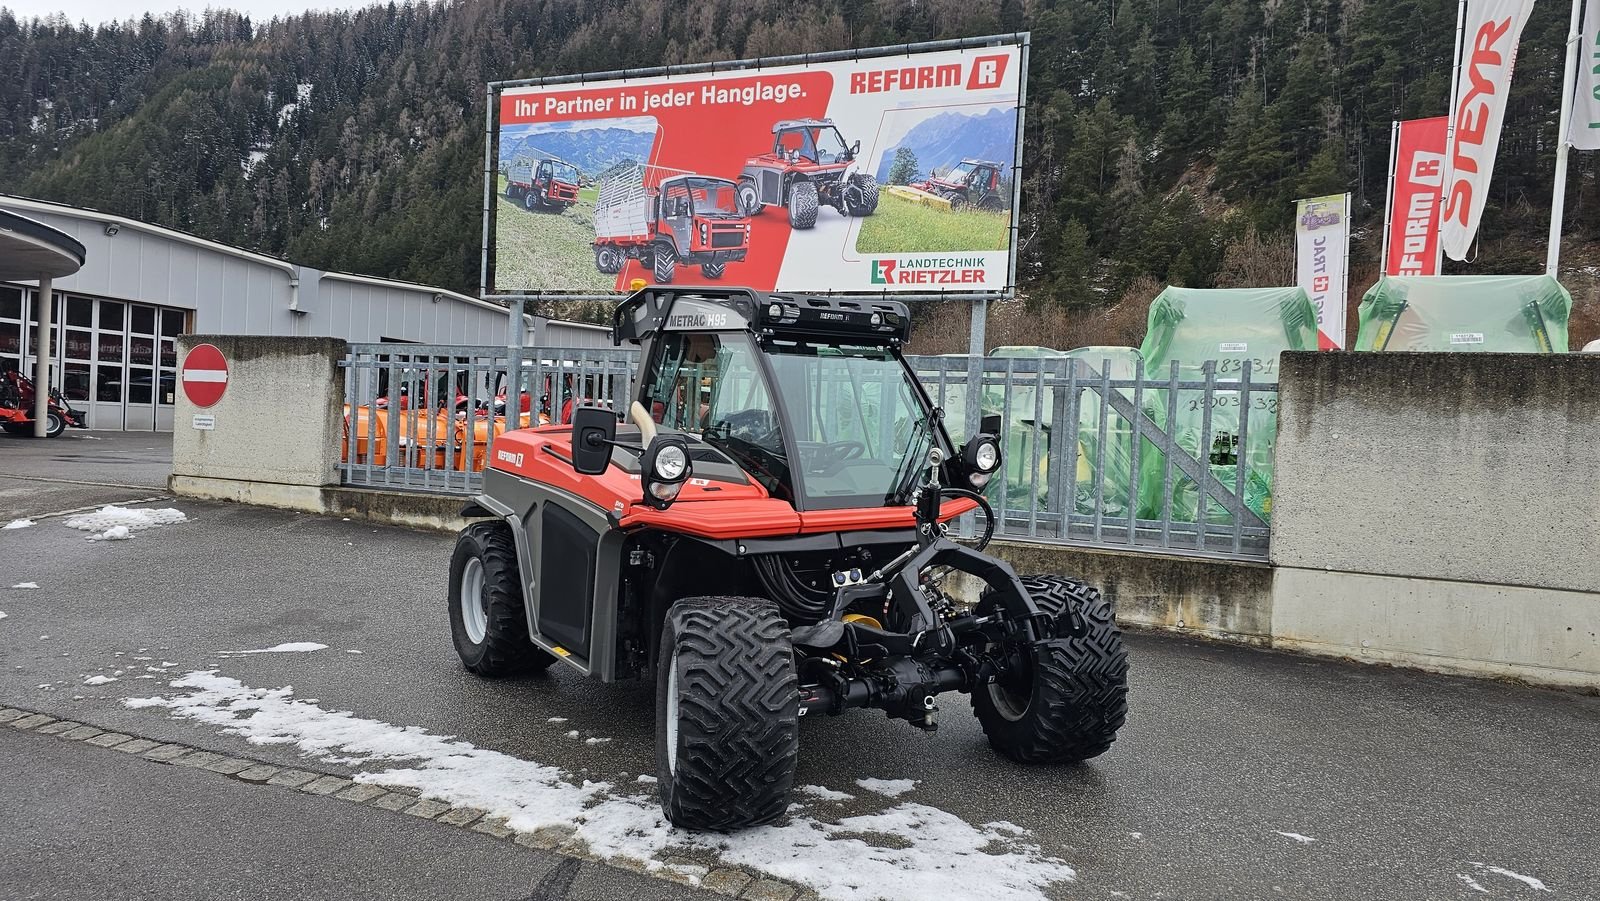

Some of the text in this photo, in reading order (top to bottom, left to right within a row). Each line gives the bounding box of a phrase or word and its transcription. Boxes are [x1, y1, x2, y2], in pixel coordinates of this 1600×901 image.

[850, 63, 962, 95] REFORM
[514, 82, 807, 117] Ihr Partner in jeder Hanglage.
[1444, 15, 1512, 228] STEYR
[899, 257, 985, 269] LANDTECHNIK
[898, 269, 986, 284] RIETZLER
[670, 313, 727, 327] METRAC H95
